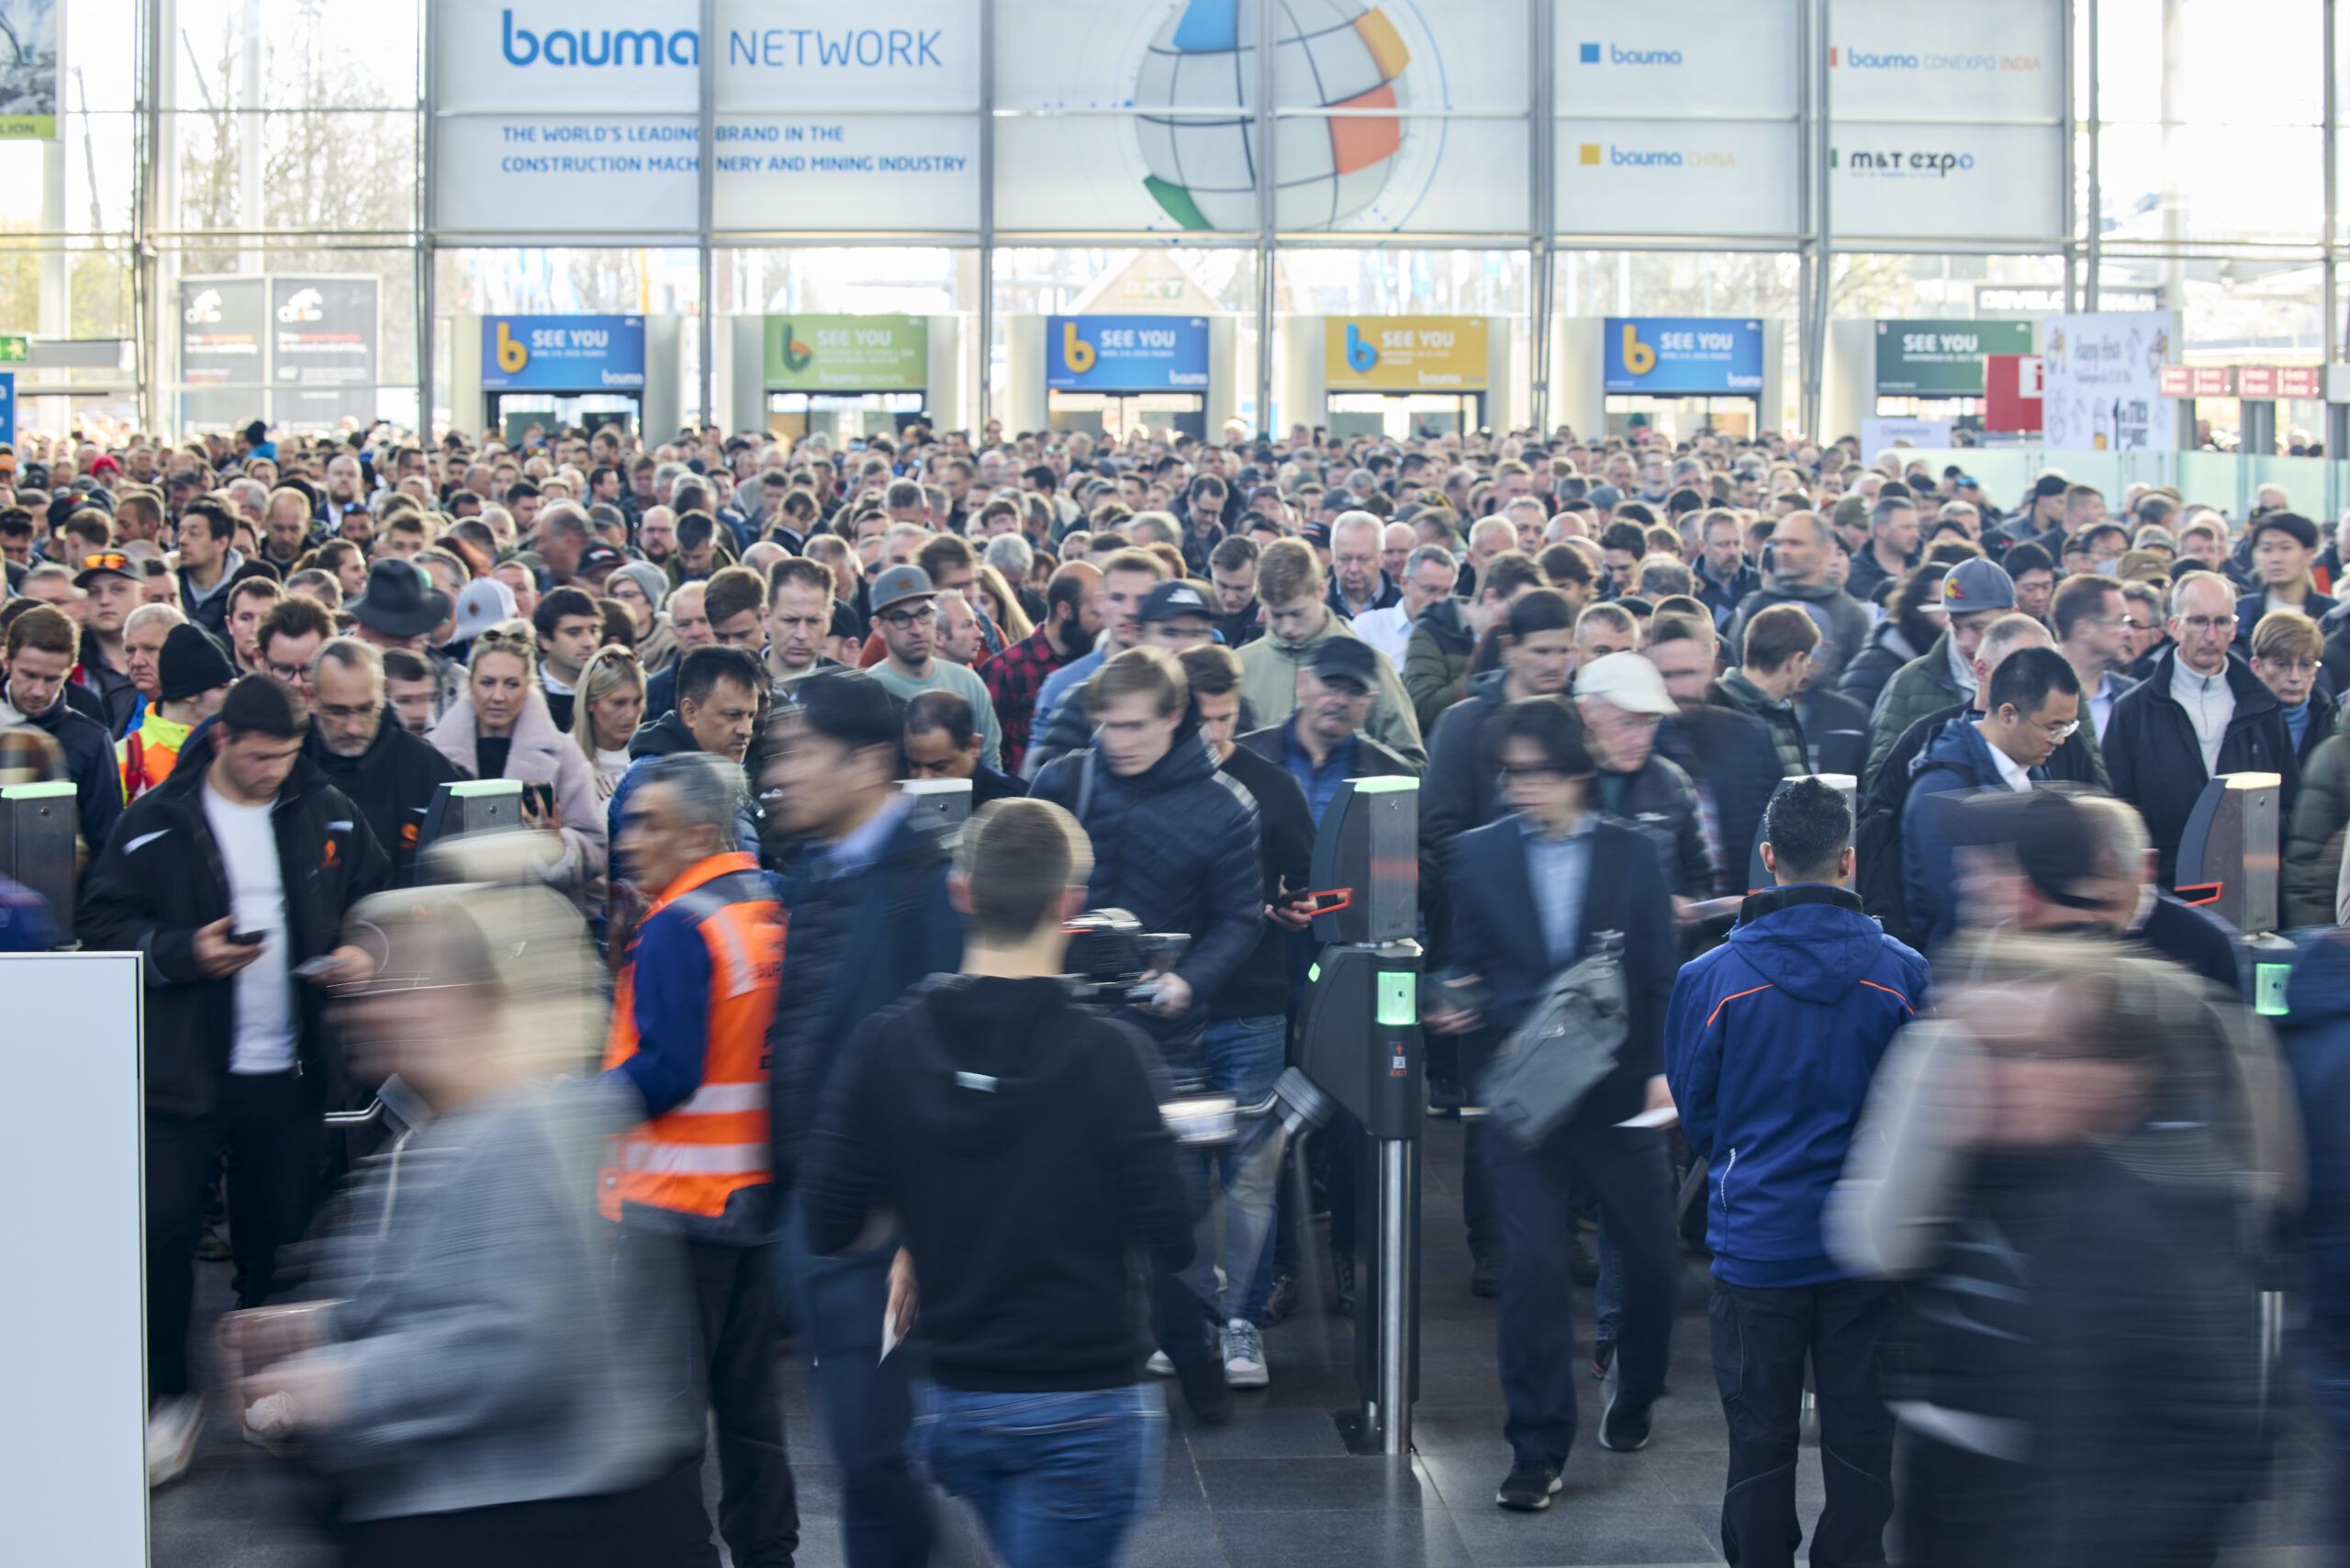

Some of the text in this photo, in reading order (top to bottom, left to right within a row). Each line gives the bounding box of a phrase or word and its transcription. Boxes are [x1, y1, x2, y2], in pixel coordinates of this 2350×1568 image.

[502, 7, 942, 68] bauma NETWORK
[1610, 43, 1683, 65] bauma
[1848, 46, 2042, 72] bauma CONEXPO INDIA
[502, 126, 536, 142] THE
[543, 126, 621, 142] WORLD'S
[715, 126, 778, 142] BRAND
[785, 126, 804, 142] IN
[810, 126, 844, 142] THE
[502, 156, 641, 173] CONSTRUCTION
[768, 156, 805, 173] AND
[811, 156, 873, 173] MINING
[878, 156, 967, 173] INDUSTRY
[1610, 144, 1735, 168] bauma CHINA
[532, 329, 610, 348] SEE YOU
[817, 329, 892, 347] SEE YOU
[1100, 329, 1176, 348] SEE YOU
[1381, 330, 1455, 348] SEE YOU
[1660, 331, 1734, 351] SEE YOU
[1902, 333, 1979, 353] SEE YOU
